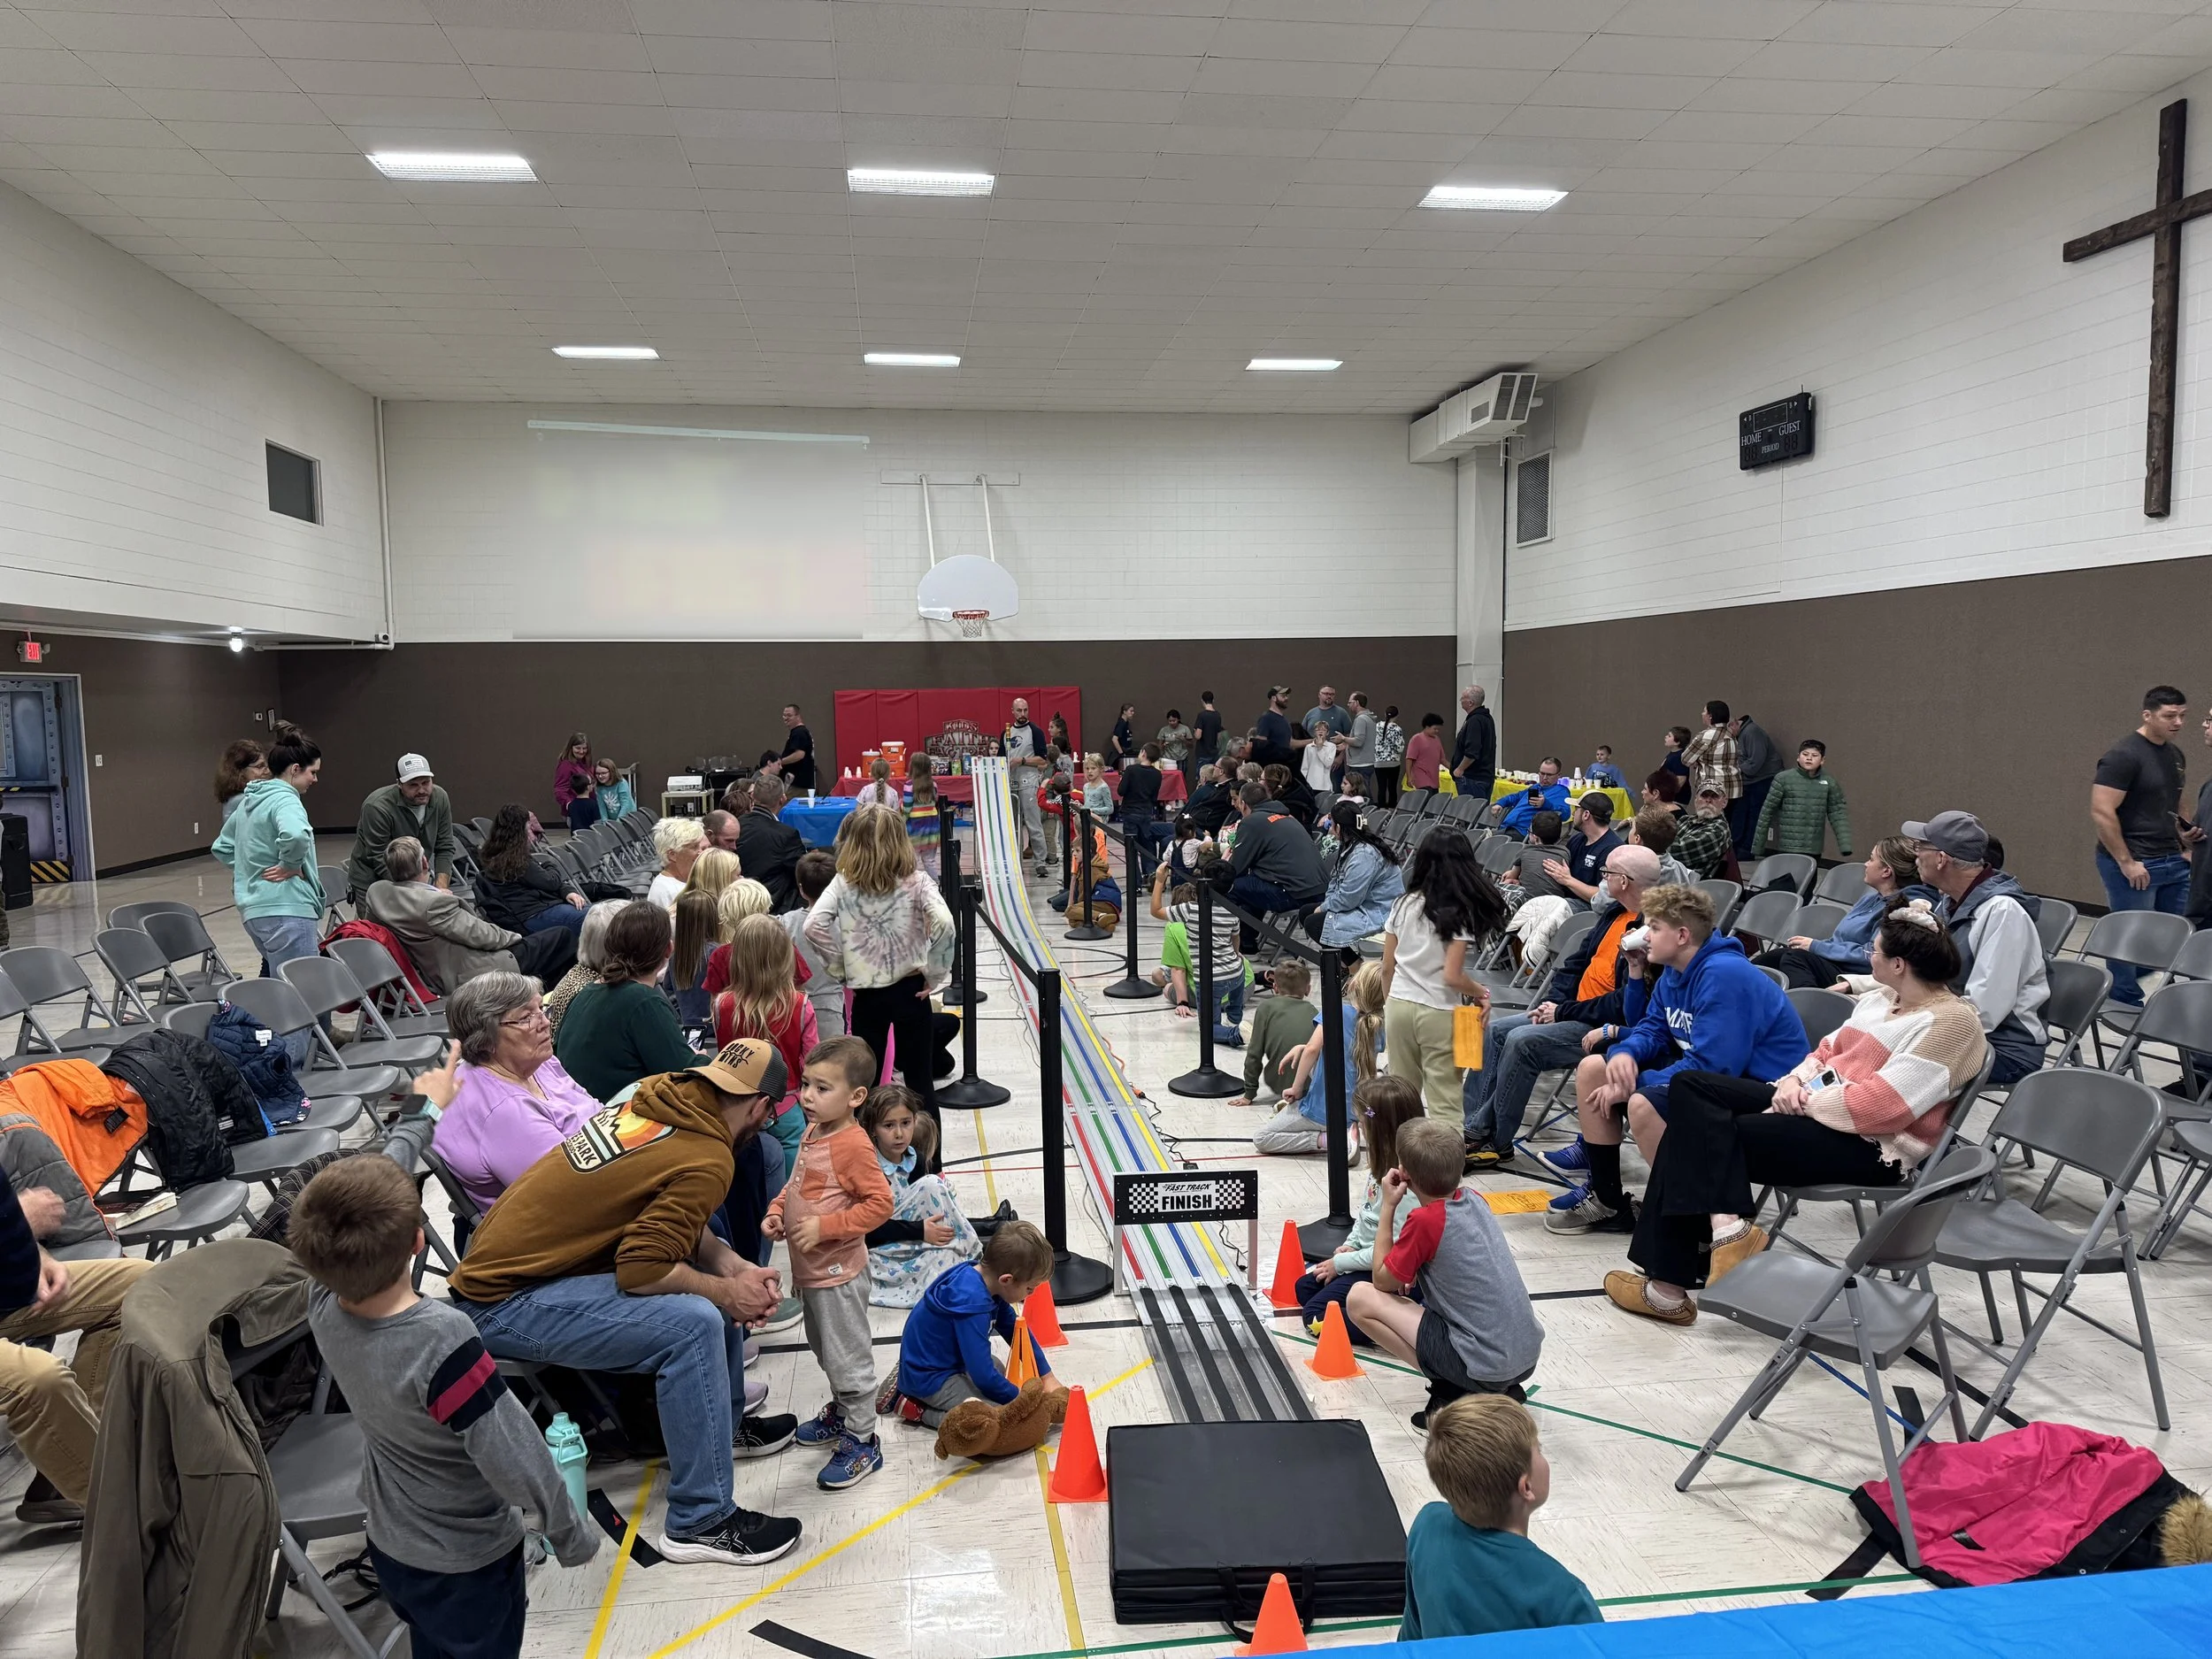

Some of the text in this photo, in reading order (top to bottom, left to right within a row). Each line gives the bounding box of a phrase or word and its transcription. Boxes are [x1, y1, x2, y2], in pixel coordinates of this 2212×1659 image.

[1741, 420, 1801, 447] HOME GUEST
[1762, 442, 1780, 454] PERIOD
[27, 642, 40, 660] EXIT
[944, 721, 978, 732] KIDS
[931, 732, 990, 746] FAITH
[926, 745, 990, 758] FACTOR
[575, 1138, 597, 1165] PARK
[1162, 1194, 1212, 1210] FINISH
